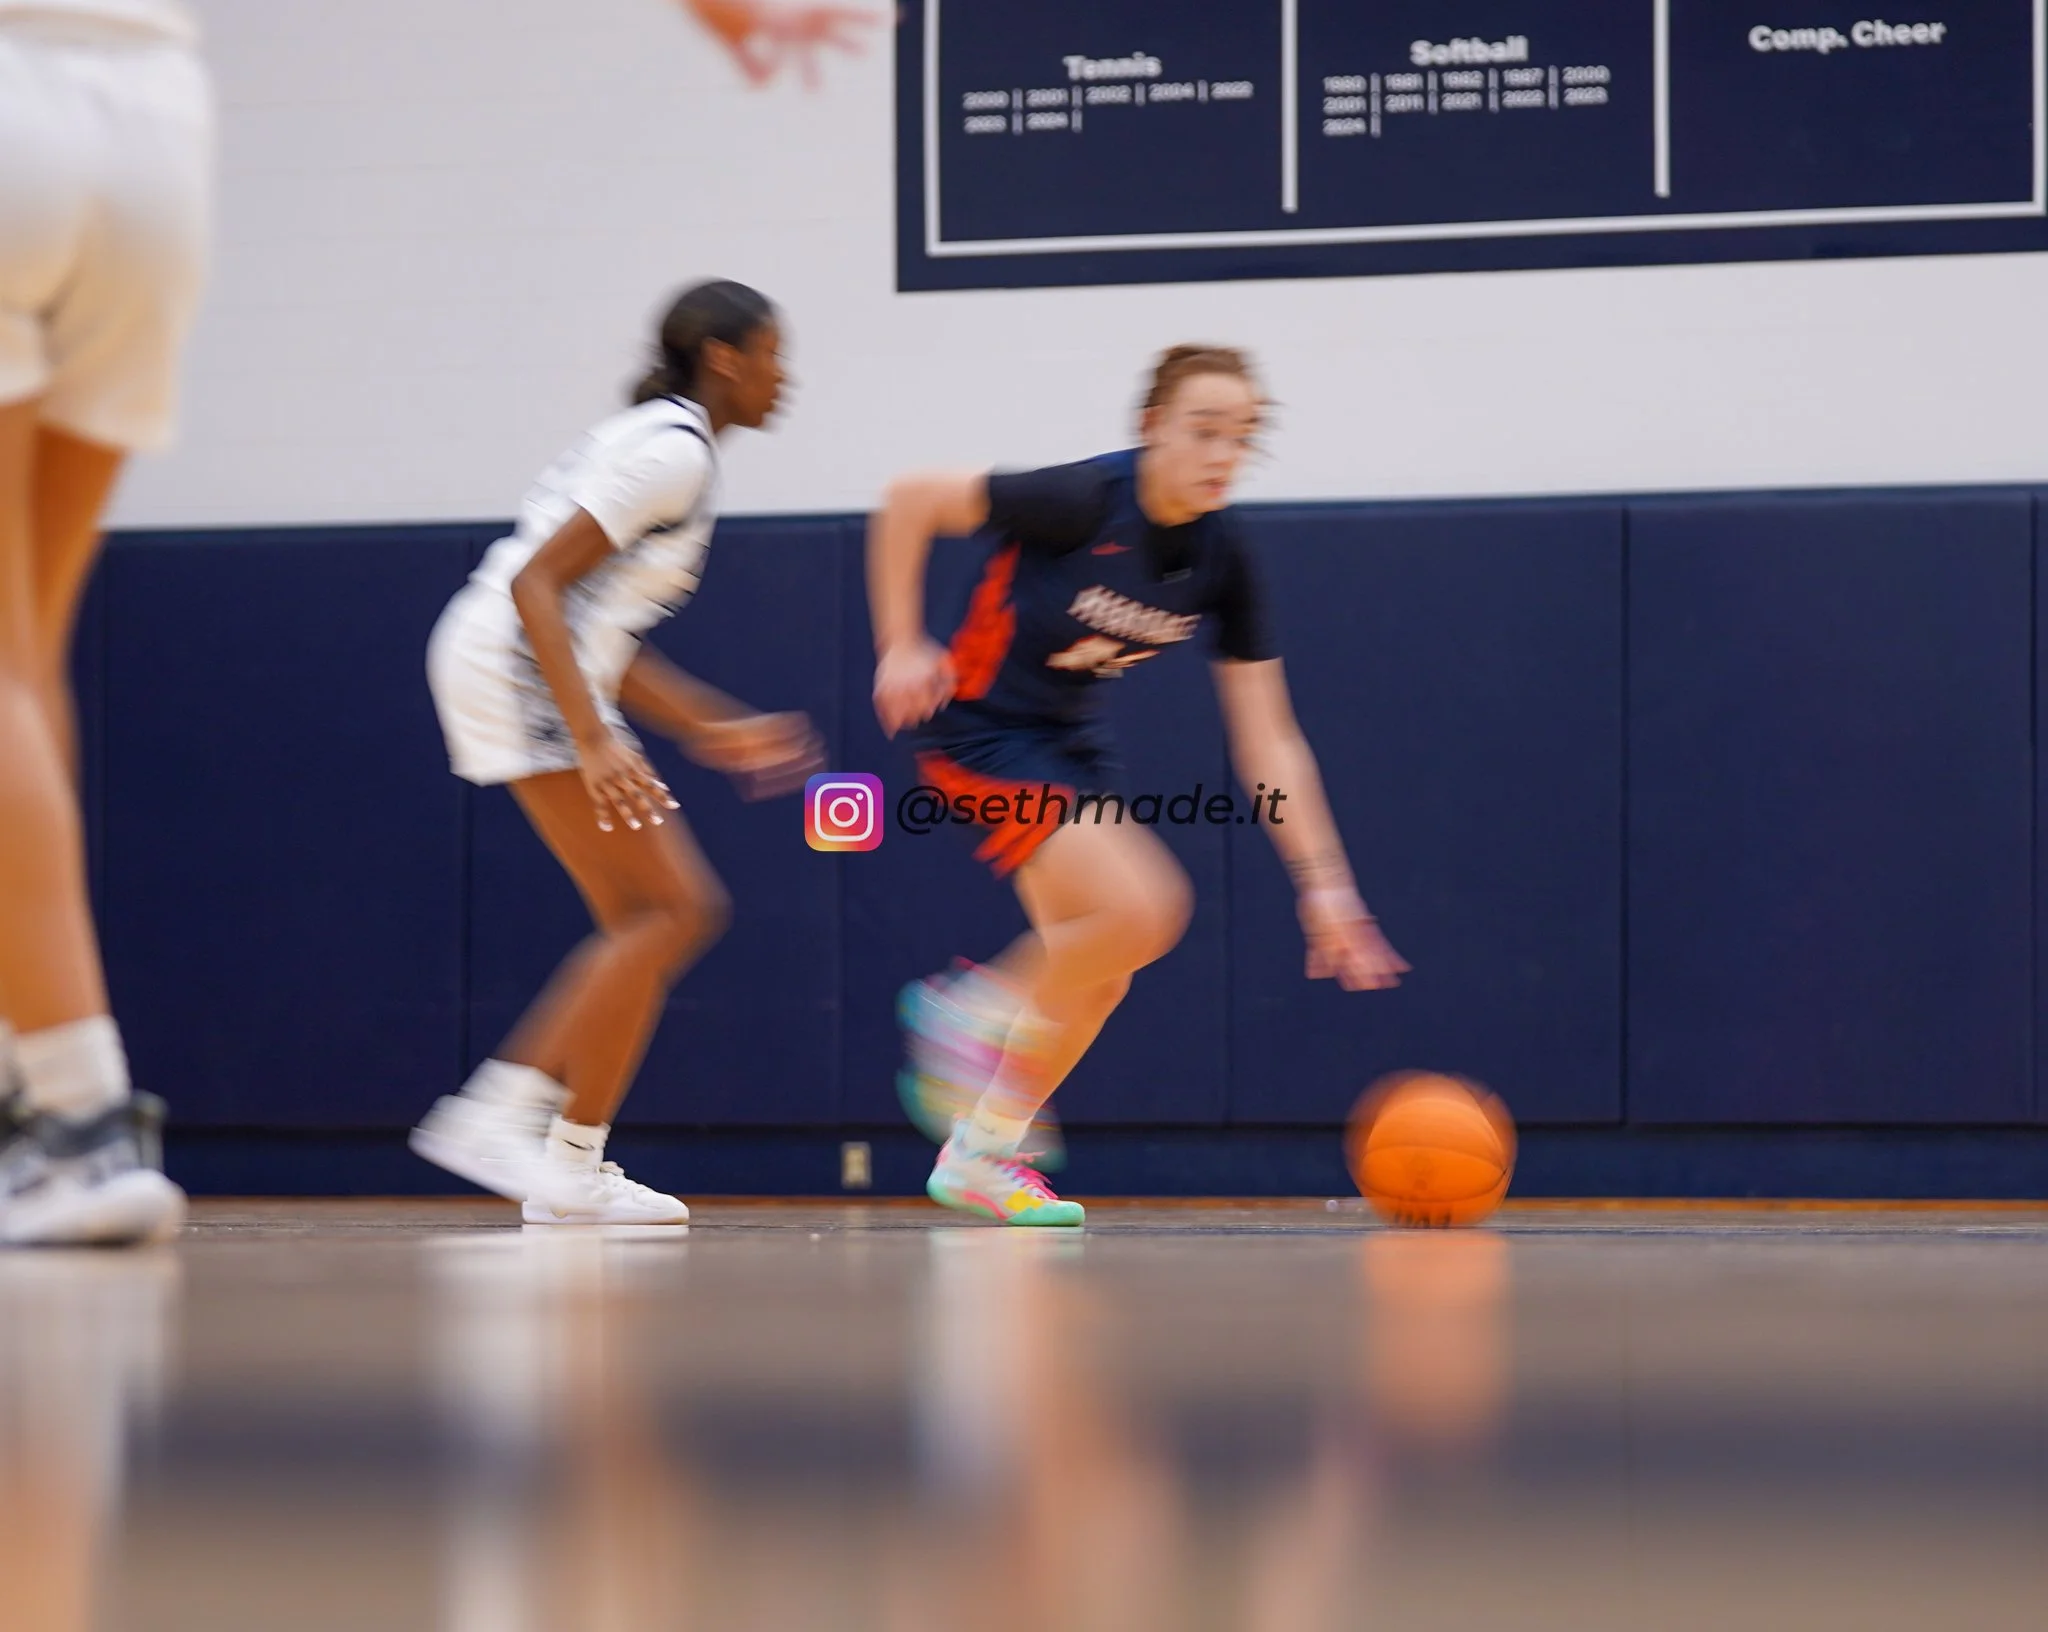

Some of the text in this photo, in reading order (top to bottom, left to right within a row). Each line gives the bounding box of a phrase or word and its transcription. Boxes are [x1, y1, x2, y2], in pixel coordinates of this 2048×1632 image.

[1410, 35, 1529, 66] Softball
[1749, 20, 1946, 54] Comp. Cheer
[1063, 52, 1162, 80] Tennis
